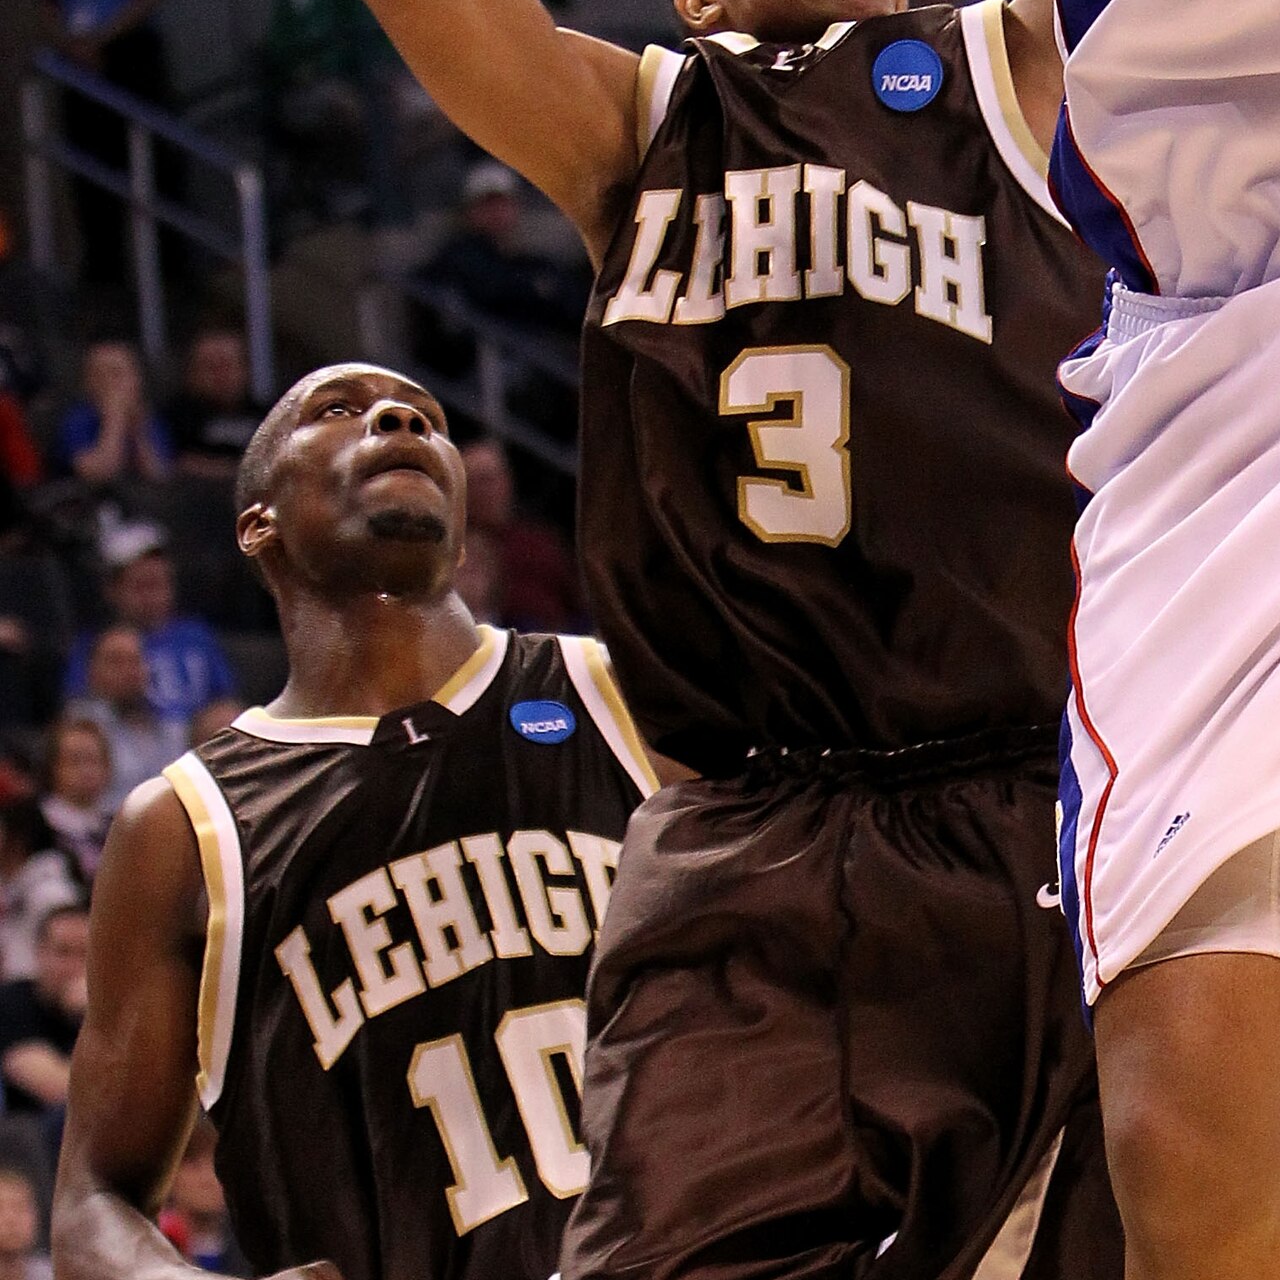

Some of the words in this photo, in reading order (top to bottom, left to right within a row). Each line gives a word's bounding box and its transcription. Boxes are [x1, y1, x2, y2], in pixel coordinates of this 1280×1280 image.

[881, 74, 932, 92] NCAA
[718, 344, 852, 548] 3
[401, 717, 431, 745] L
[520, 718, 568, 735] NCAA
[406, 999, 592, 1237] 10
